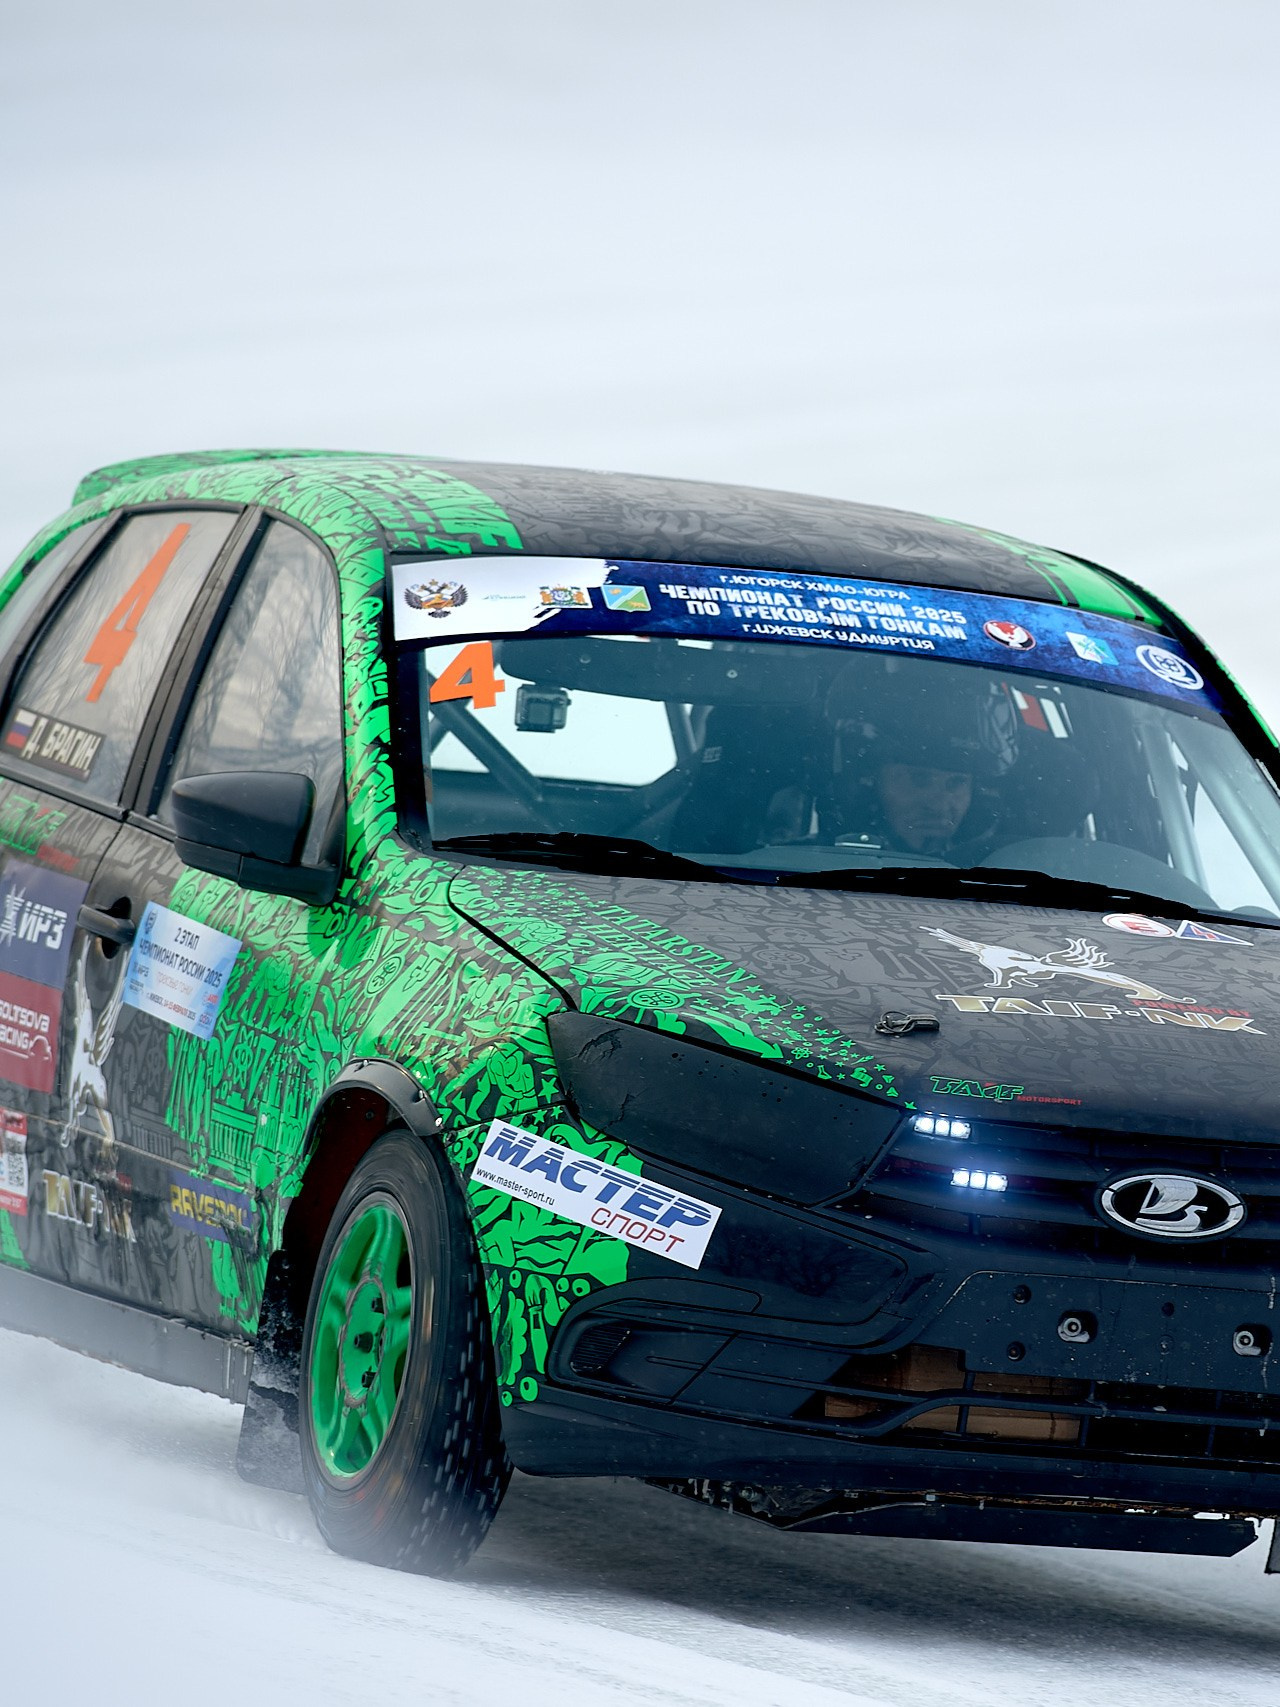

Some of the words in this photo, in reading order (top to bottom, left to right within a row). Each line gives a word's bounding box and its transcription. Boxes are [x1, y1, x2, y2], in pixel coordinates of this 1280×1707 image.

[83, 523, 192, 703] 4
[659, 584, 803, 607] ЧЕМПИОНАТ
[817, 596, 906, 617] РОССИИ
[911, 605, 967, 624] 2025
[805, 581, 911, 600] ХМАО-ЮГРА
[687, 601, 720, 617] ПО
[731, 604, 862, 628] ТРЕКОВЫМ
[868, 618, 968, 641] ГОНКАМ
[837, 630, 935, 650] УДМУРТИЯ
[429, 641, 506, 710] 4
[21, 717, 49, 760] Д.
[41, 722, 102, 771] БРАГИН
[18, 901, 67, 950] ИРЗ
[174, 927, 182, 943] 2
[179, 930, 200, 950] ЭТАП
[593, 905, 757, 985] TATARSTAN
[139, 938, 180, 969] ЧЕМПИОНАТ
[177, 956, 206, 981] РОССИИ
[204, 968, 223, 988] 2025
[577, 923, 719, 987] HERITAGE
[1017, 1095, 1082, 1105] MOTORSPORT
[476, 1168, 555, 1206] www.master-sport.ru
[484, 1127, 712, 1228] МАСТЕР
[590, 1207, 685, 1253] СПОРТ
